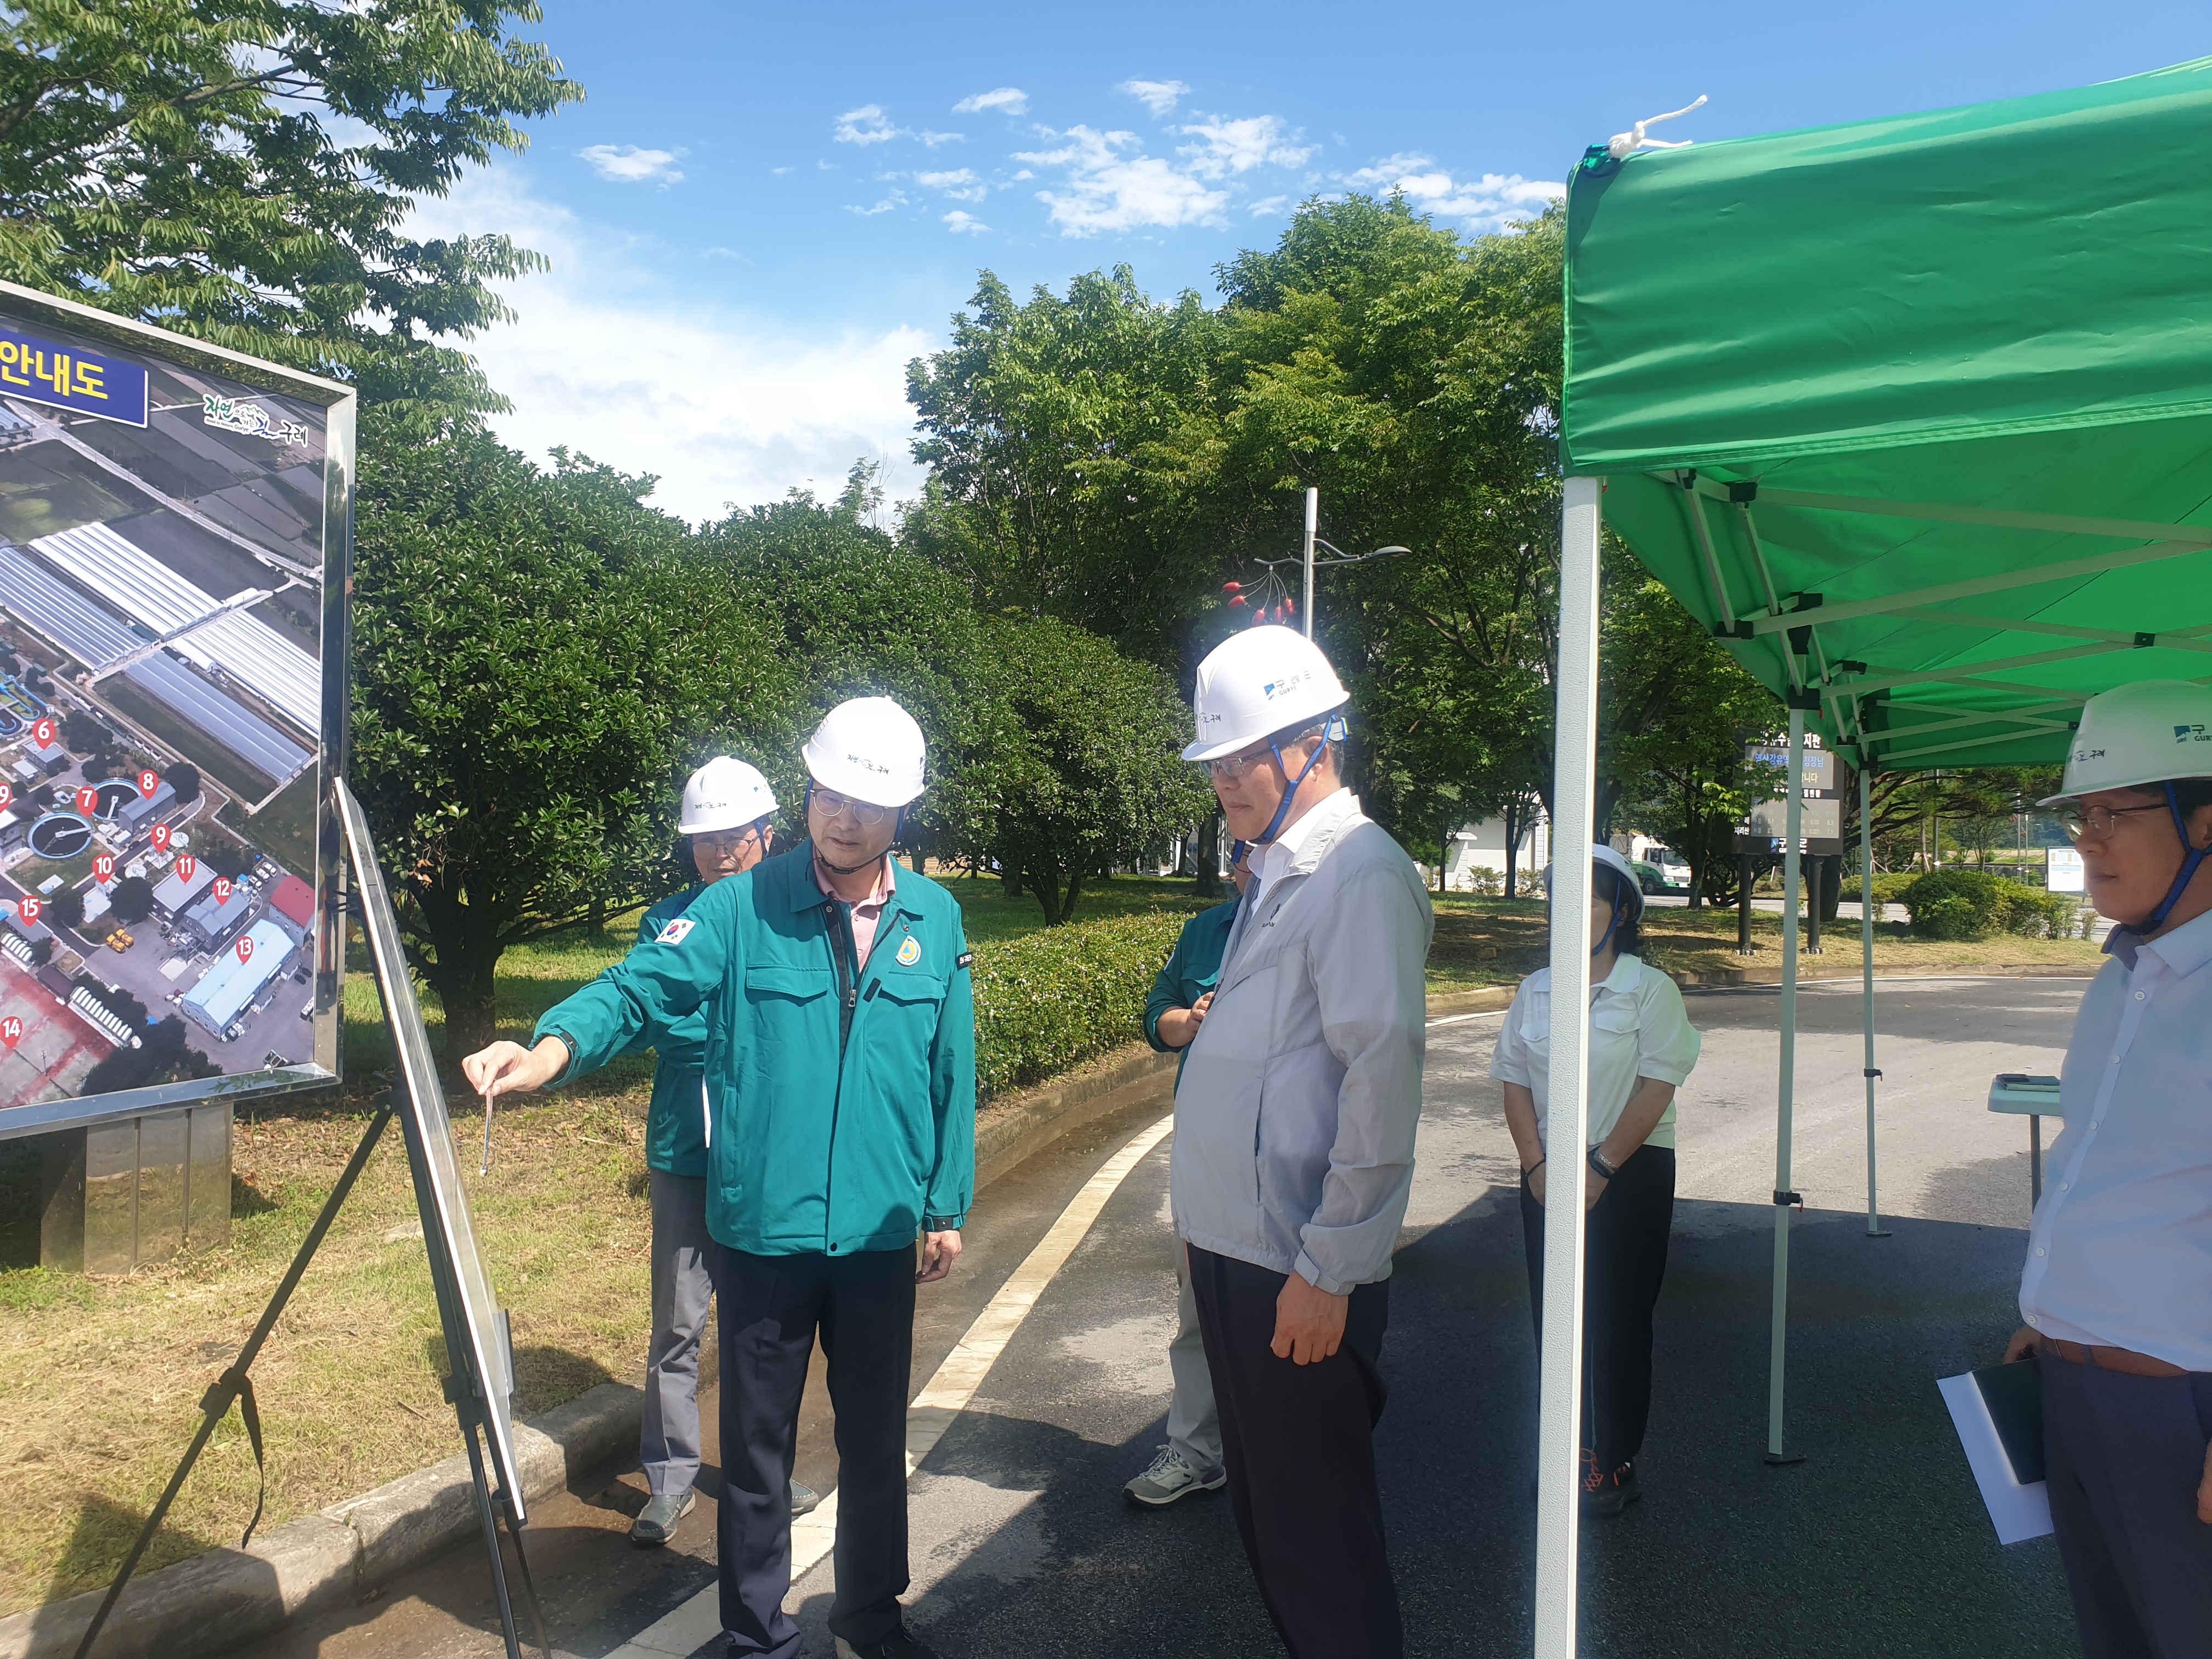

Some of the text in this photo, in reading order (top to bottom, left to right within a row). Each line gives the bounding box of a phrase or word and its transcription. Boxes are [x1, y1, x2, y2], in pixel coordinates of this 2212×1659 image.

[0, 341, 108, 399] 안내도
[280, 422, 306, 445] 구례
[1279, 685, 1297, 695] GURYE
[38, 721, 49, 739] 6
[2192, 725, 2205, 735] 구
[143, 773, 154, 789] 8
[82, 790, 92, 806] 7
[156, 827, 166, 843] 9
[1734, 827, 1750, 835] 지리산
[97, 857, 112, 874] 10
[179, 857, 191, 874] 11
[216, 880, 229, 896] 12
[22, 898, 38, 916] 15
[239, 939, 251, 955] 13
[3, 1019, 20, 1037] 14
